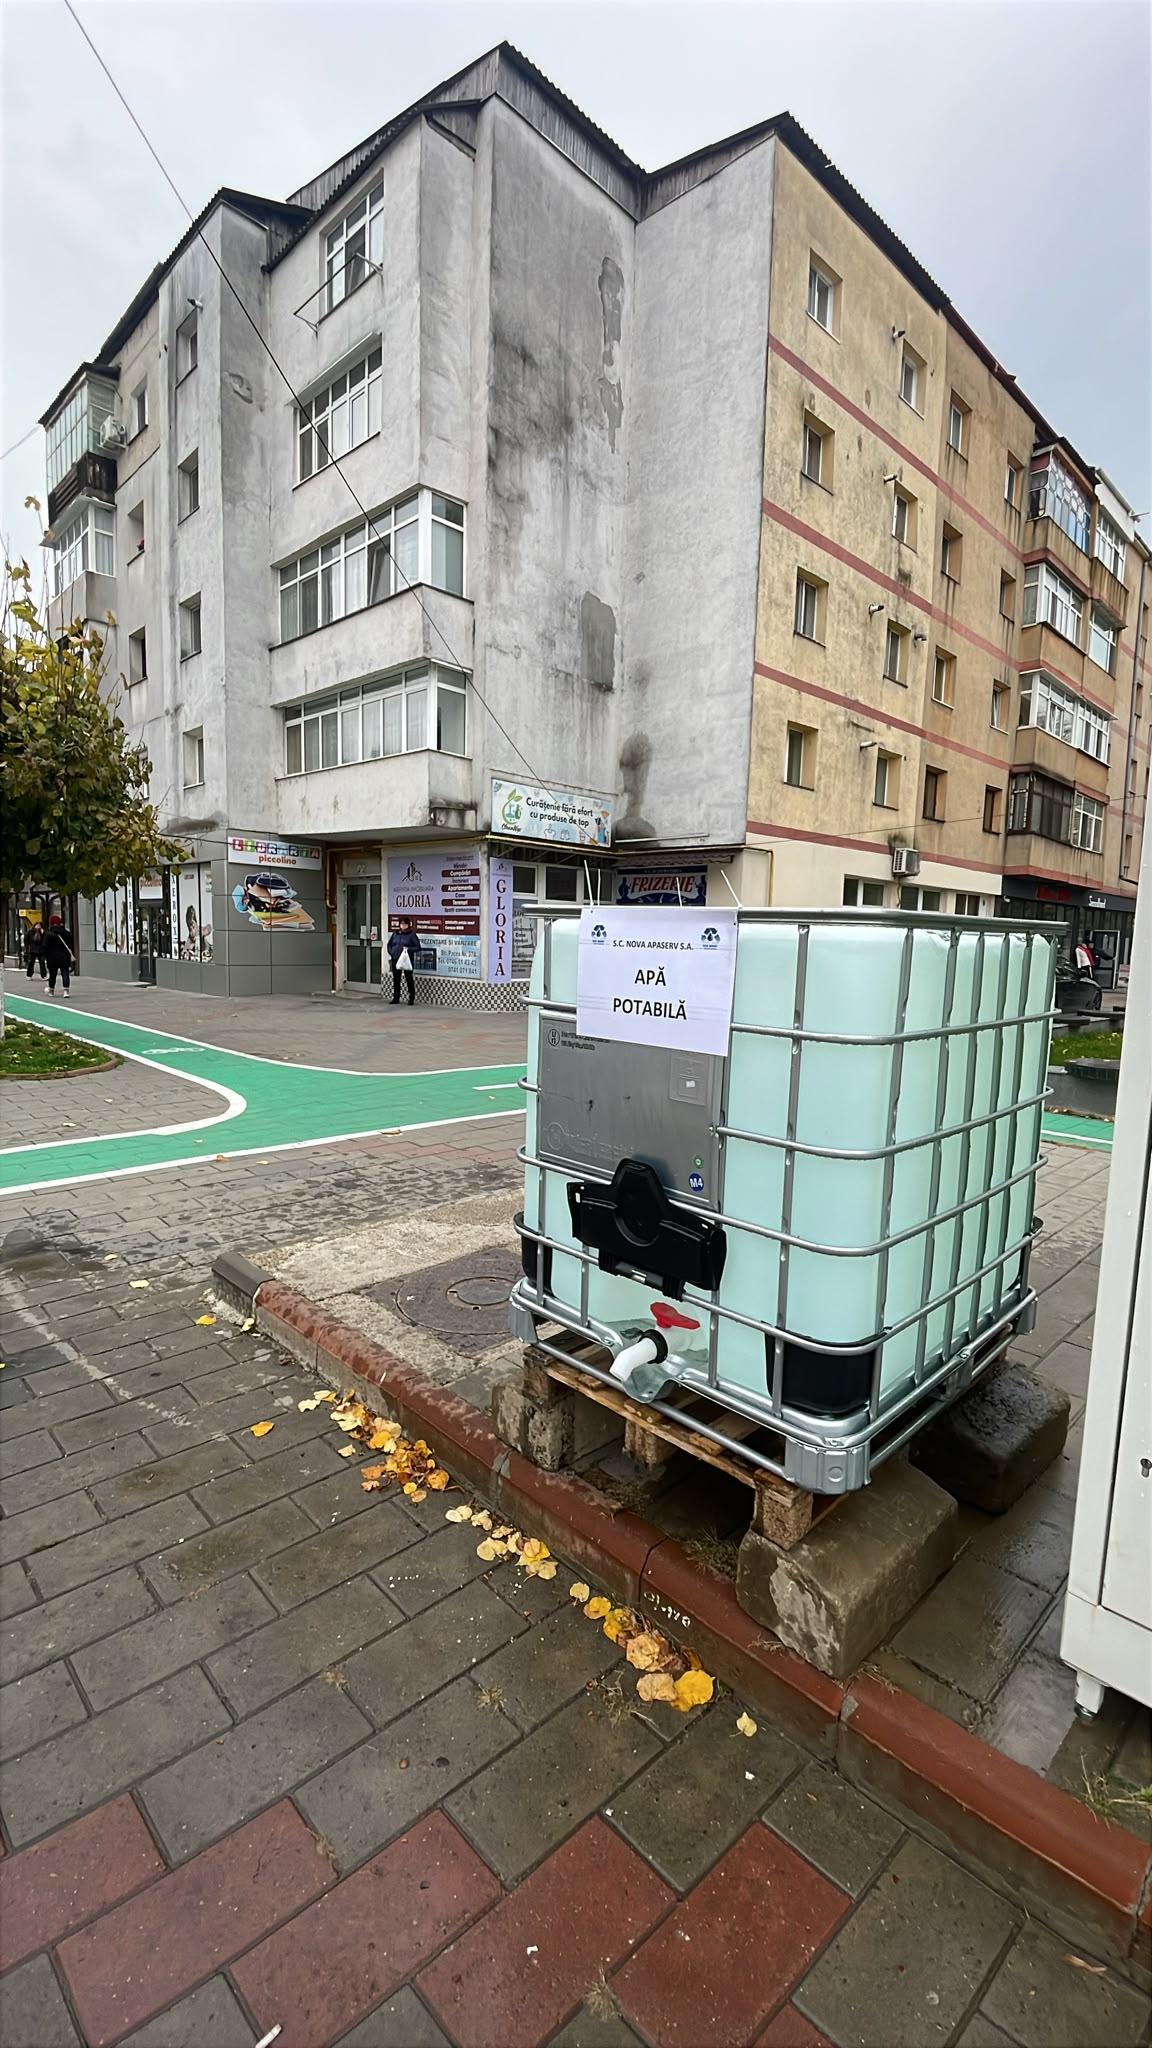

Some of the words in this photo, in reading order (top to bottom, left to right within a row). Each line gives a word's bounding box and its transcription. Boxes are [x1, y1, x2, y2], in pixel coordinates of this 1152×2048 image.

[526, 797, 561, 811] Curățenie
[562, 803, 576, 814] fără
[577, 806, 593, 817] efort
[530, 811, 538, 819] cu
[540, 812, 568, 823] produse
[568, 815, 577, 825] de
[578, 818, 590, 828] top
[258, 855, 297, 866] piccolino
[631, 875, 696, 894] FRIZERIE
[396, 894, 431, 908] GLORIA
[495, 879, 507, 976] GLORIA
[613, 939, 625, 948] S.C.
[626, 940, 646, 949] NOVA
[647, 940, 679, 950] APASERV
[680, 942, 694, 951] S.A.
[634, 966, 667, 987] APĂ
[613, 997, 687, 1020] POTABILĂ
[689, 1177, 704, 1189] M4
